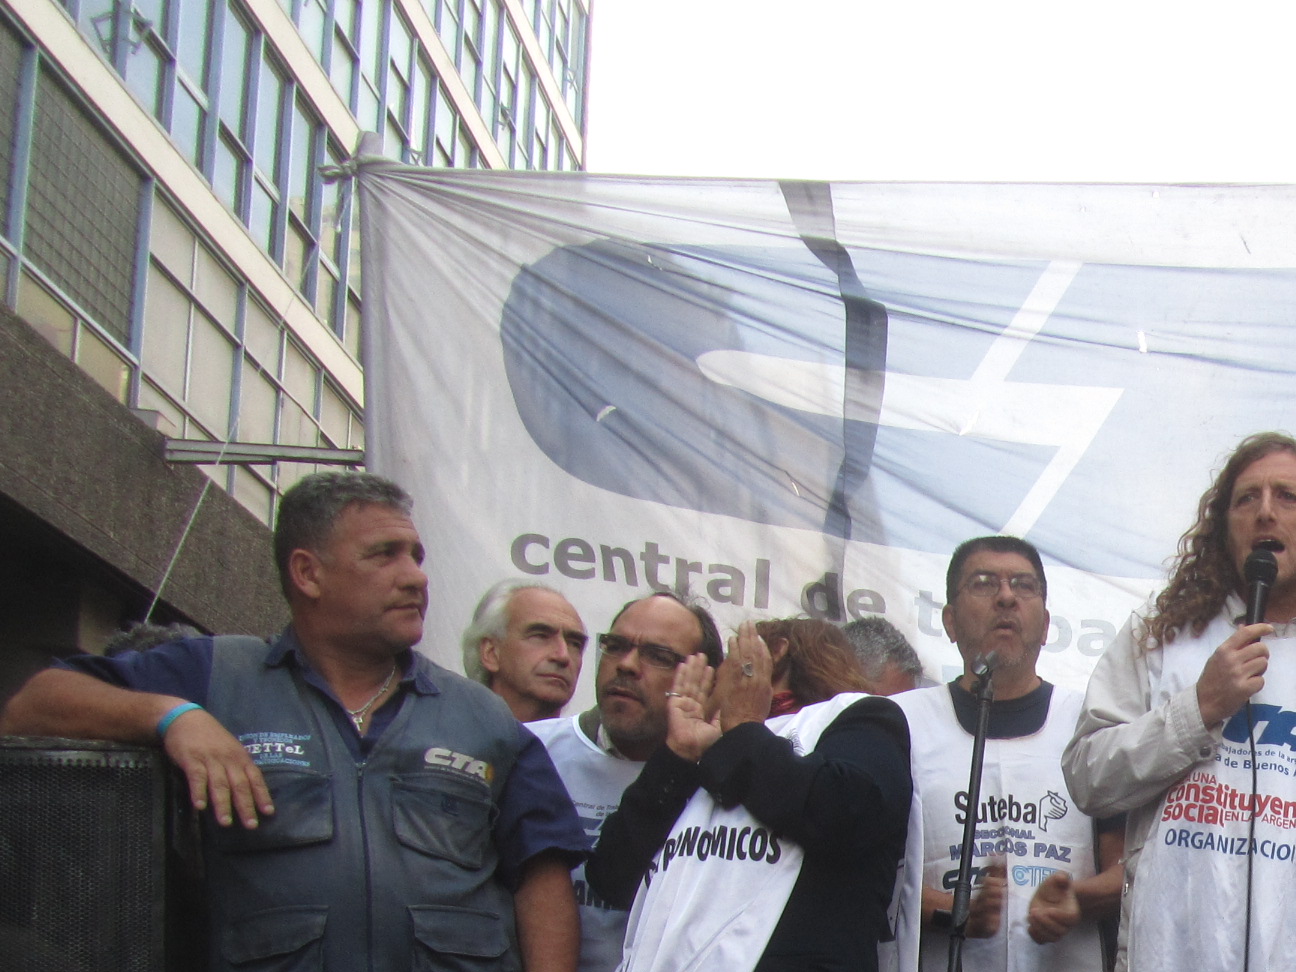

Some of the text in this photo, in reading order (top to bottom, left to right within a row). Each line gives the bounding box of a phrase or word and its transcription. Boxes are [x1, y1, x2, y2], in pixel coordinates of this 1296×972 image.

[510, 532, 887, 622] central de
[425, 748, 487, 780] CTA
[1224, 756, 1238, 768] de
[954, 791, 1037, 824] Suteba
[1034, 843, 1072, 863] PAZ
[1165, 828, 1296, 863] ORGANIZACIO
